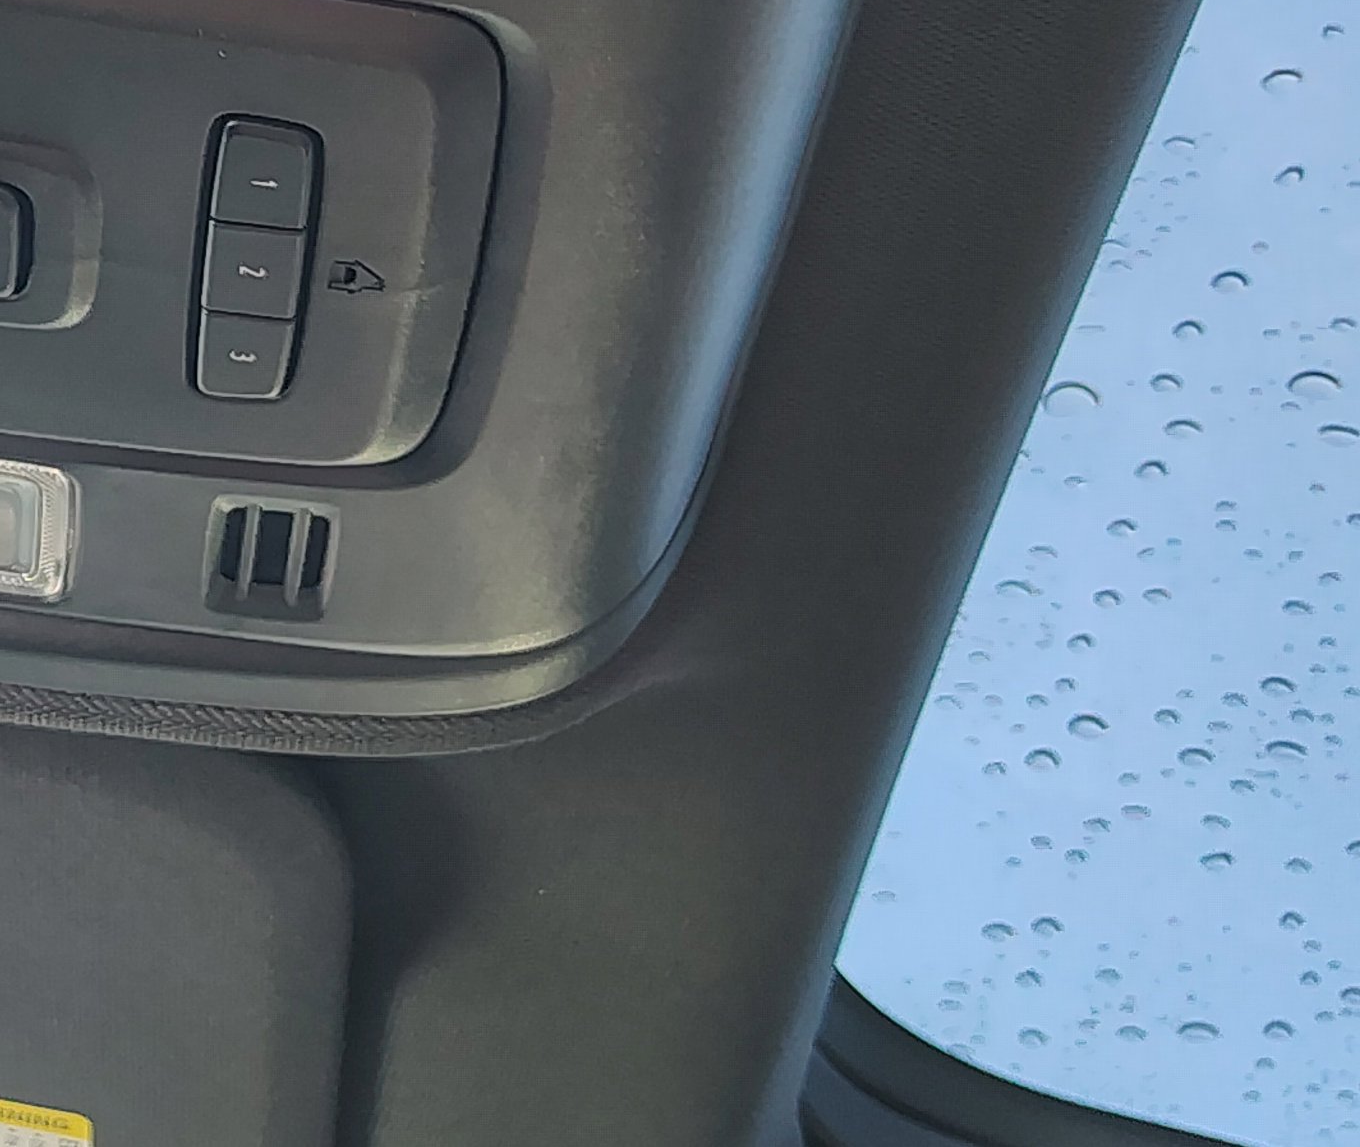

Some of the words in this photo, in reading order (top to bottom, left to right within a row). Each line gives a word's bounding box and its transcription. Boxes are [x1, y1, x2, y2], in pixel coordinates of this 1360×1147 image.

[250, 179, 279, 188] 1
[238, 264, 268, 279] 2
[229, 349, 257, 363] 3
